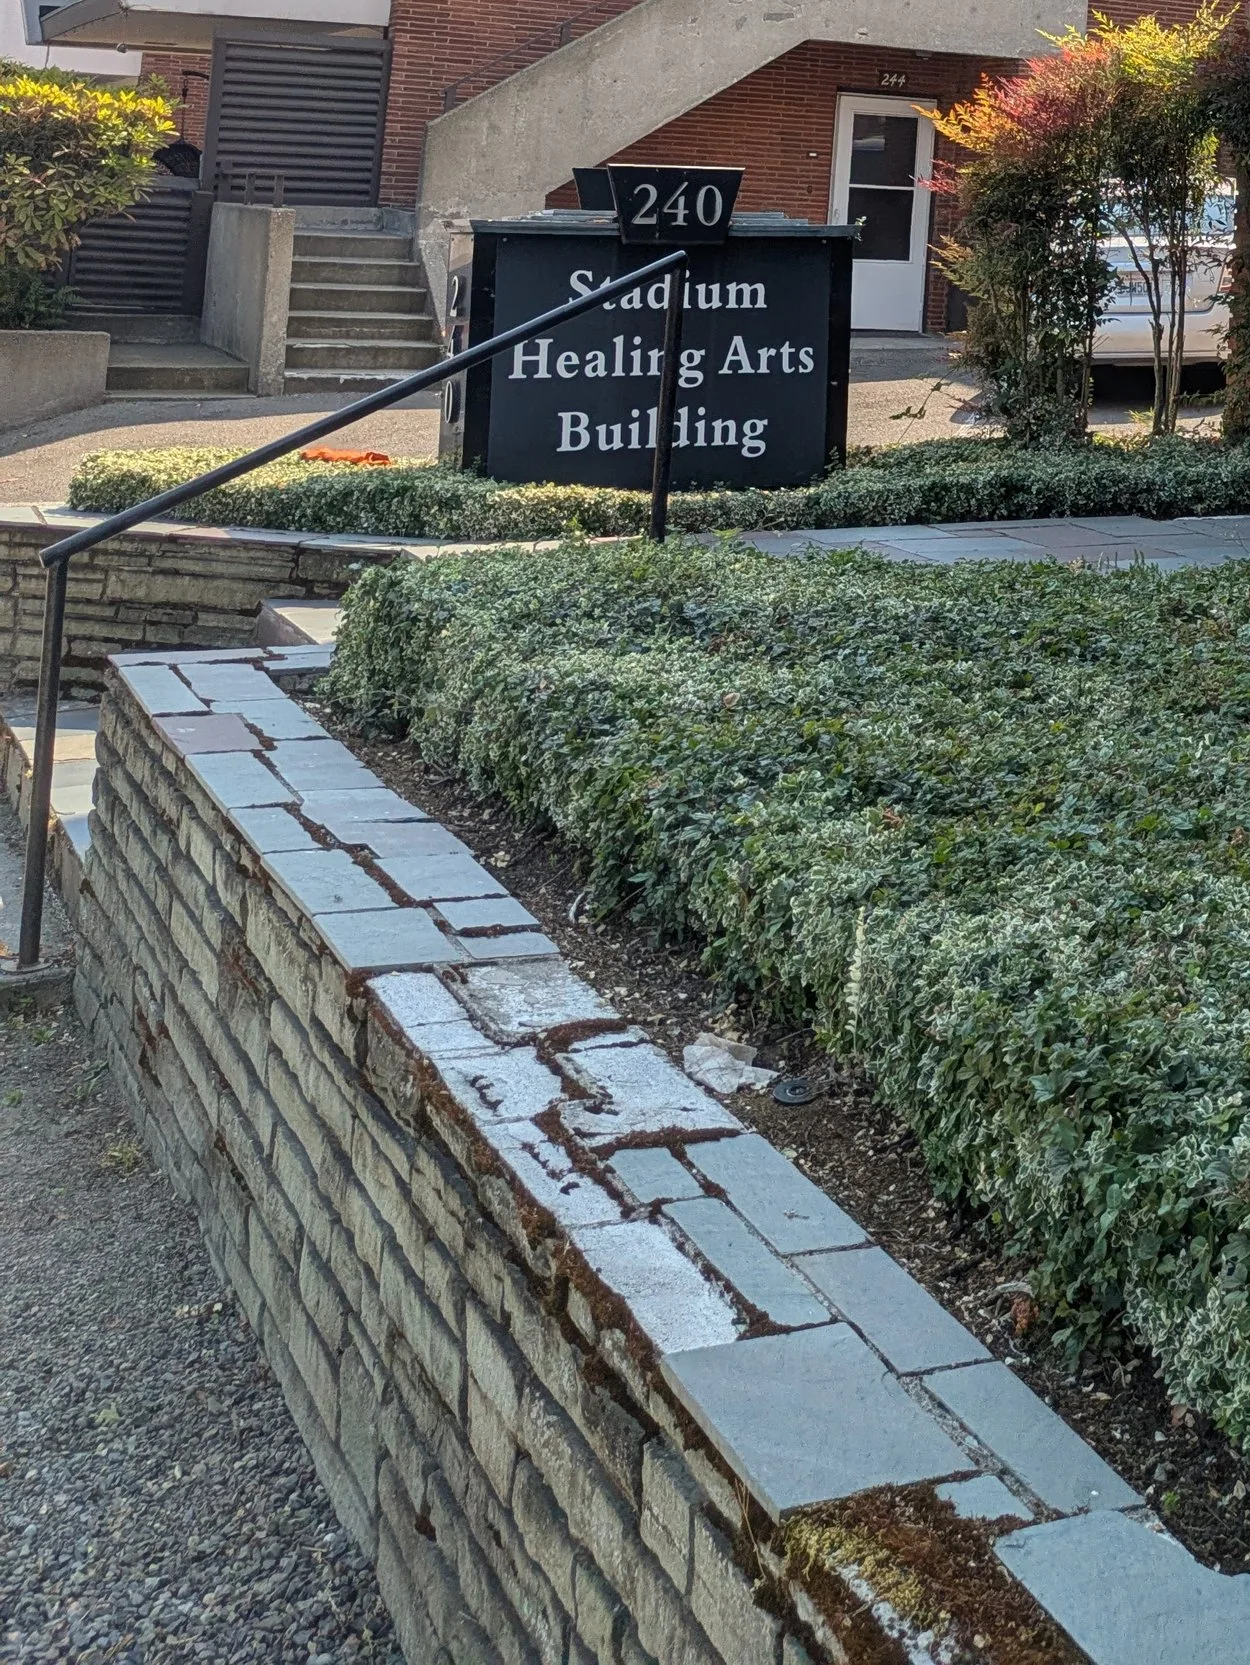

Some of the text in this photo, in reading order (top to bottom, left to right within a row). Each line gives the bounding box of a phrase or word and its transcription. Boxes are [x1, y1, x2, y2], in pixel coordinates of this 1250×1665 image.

[881, 73, 906, 87] 244
[631, 181, 724, 227] 240
[508, 334, 815, 388] Healing Arts
[556, 405, 769, 458] Building
